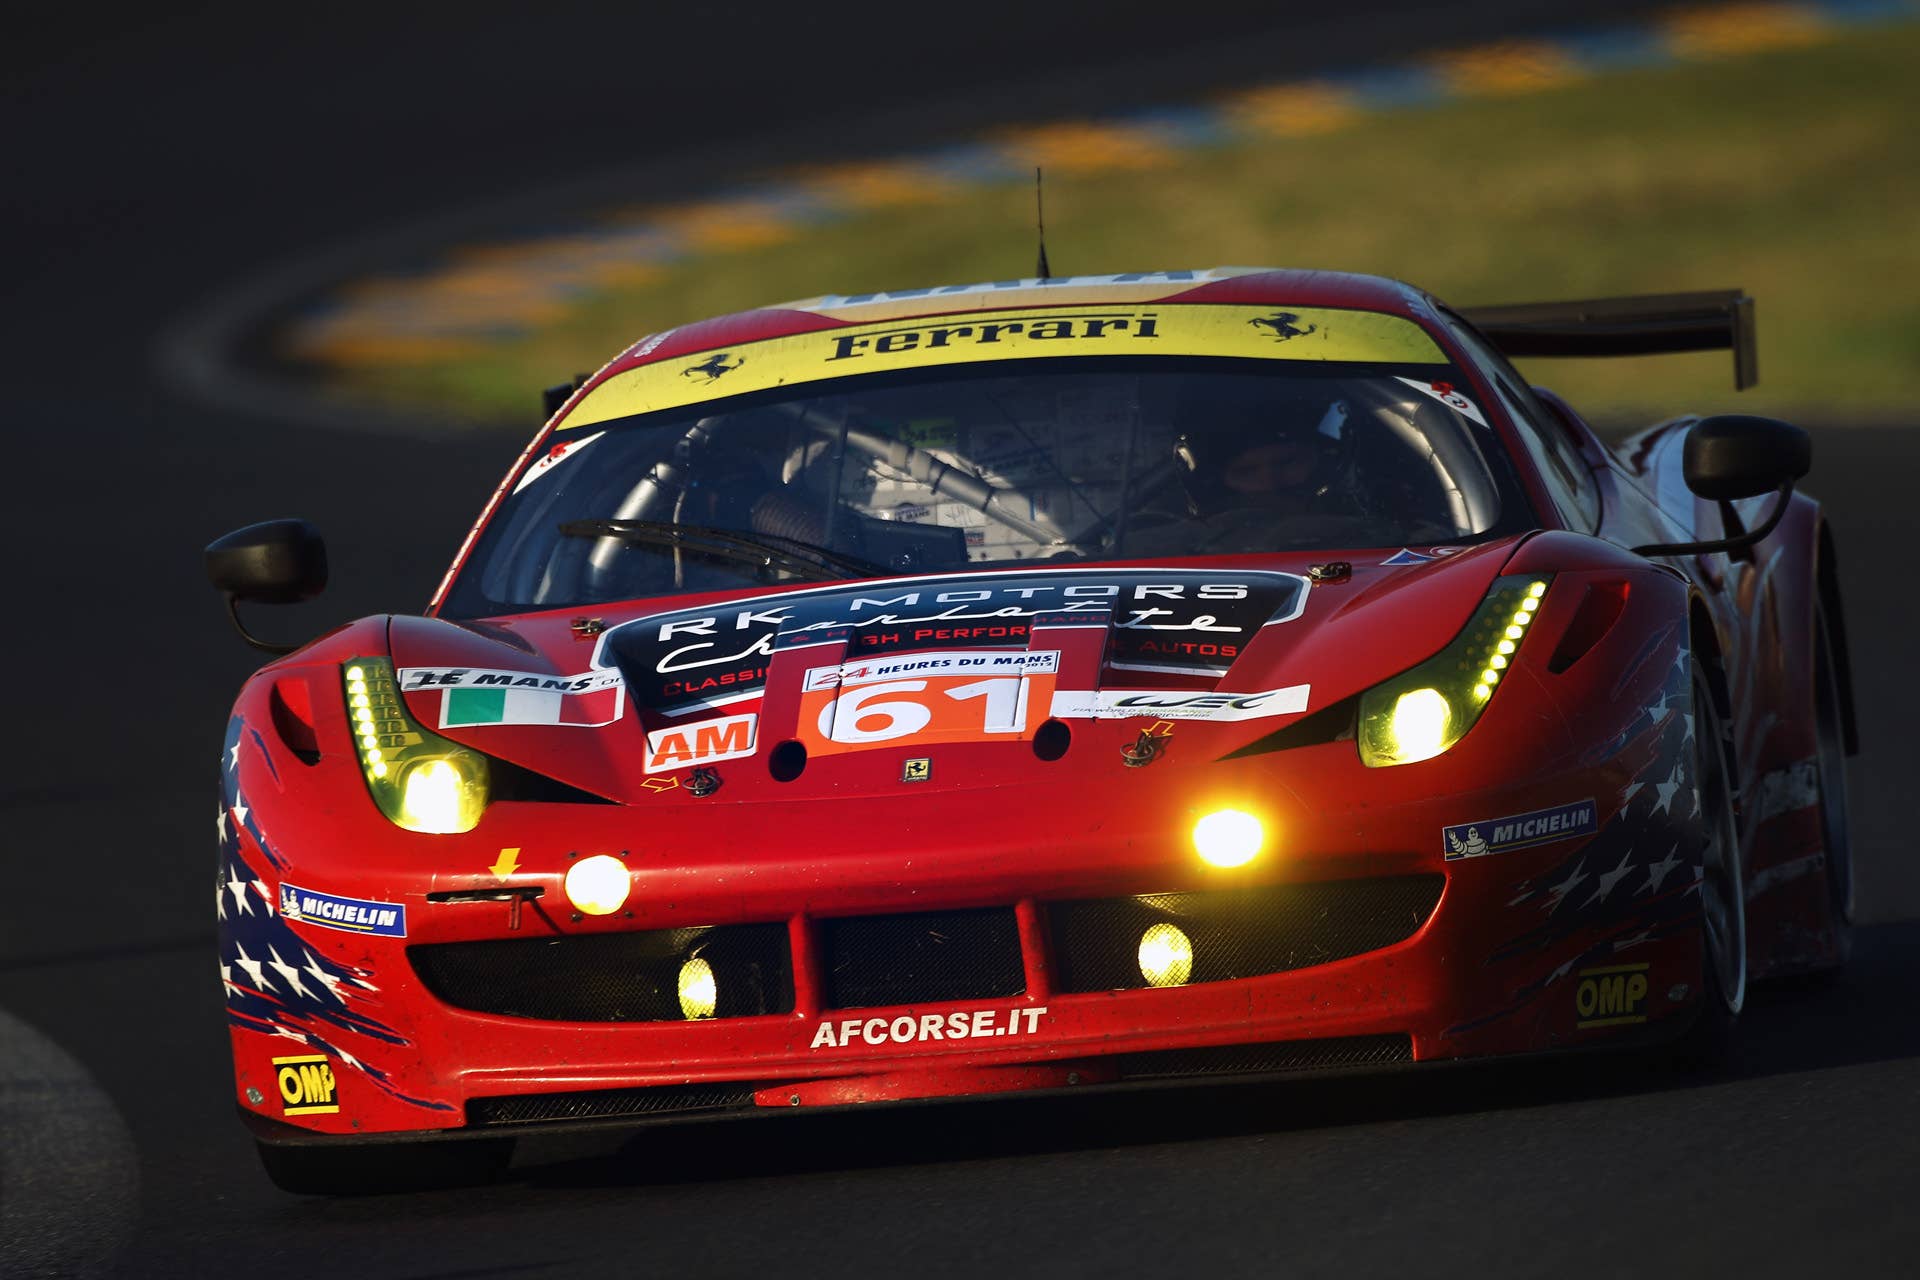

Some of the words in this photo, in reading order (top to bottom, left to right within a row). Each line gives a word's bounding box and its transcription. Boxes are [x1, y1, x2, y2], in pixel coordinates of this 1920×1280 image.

[825, 313, 1159, 361] Ferrari
[658, 605, 796, 642] RK
[850, 584, 1249, 611] MOTORS
[420, 673, 458, 685] LE
[473, 674, 594, 692] MANS
[663, 667, 771, 697] CLASSI
[1139, 641, 1239, 657] AUTOS
[877, 659, 951, 675] HEURES
[958, 657, 986, 667] DU
[993, 655, 1052, 665] MANS
[818, 677, 1030, 743] 61
[1115, 692, 1278, 710] WEC
[650, 719, 749, 767] AM
[1492, 808, 1590, 844] MICHELIN
[302, 897, 397, 927] MICHELIN
[1576, 973, 1648, 1018] OMP
[810, 1007, 1048, 1049] AFCORSE.IT
[278, 1064, 336, 1105] OMP
